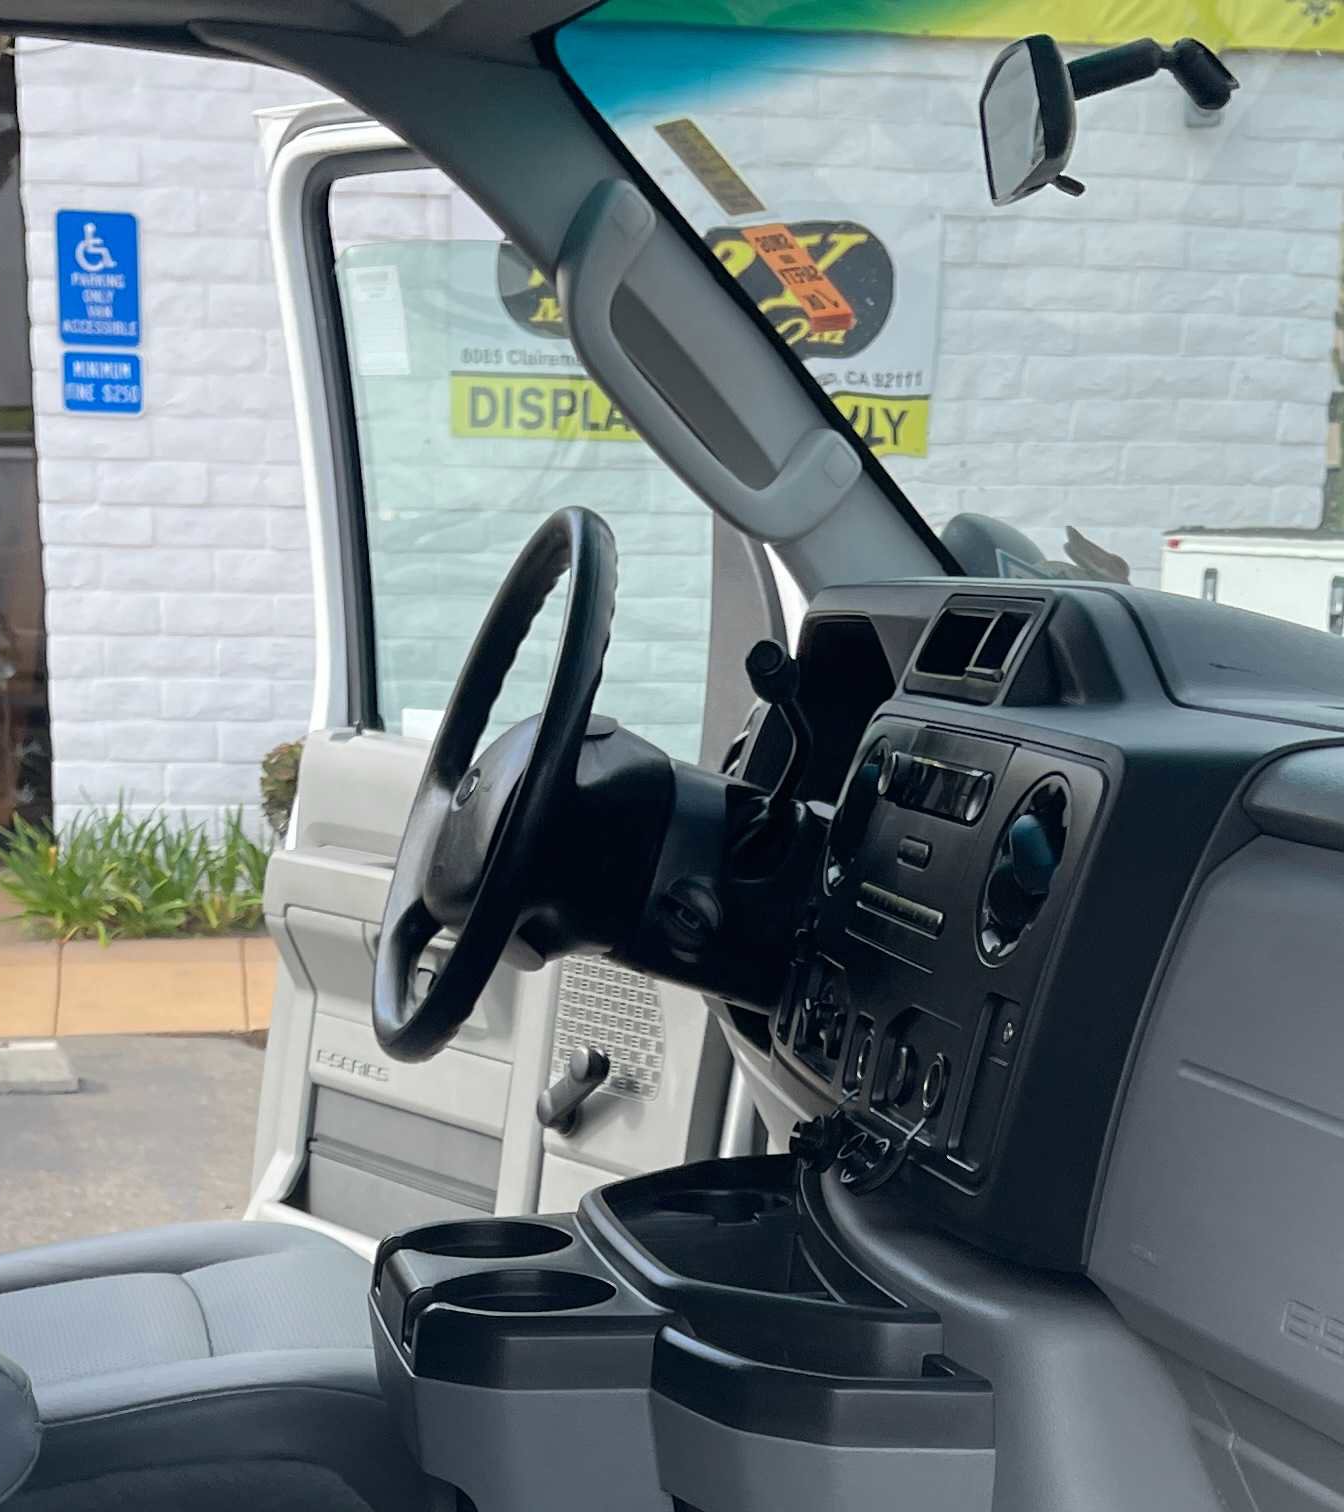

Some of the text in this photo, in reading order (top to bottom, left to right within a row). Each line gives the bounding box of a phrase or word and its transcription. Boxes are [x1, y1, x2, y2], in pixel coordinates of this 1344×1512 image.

[71, 273, 126, 288] PARKING
[82, 289, 115, 304] ONLY
[63, 320, 137, 337] ACCESSIBLE
[72, 361, 131, 380] MINIMUM
[469, 386, 631, 432] DISPLA
